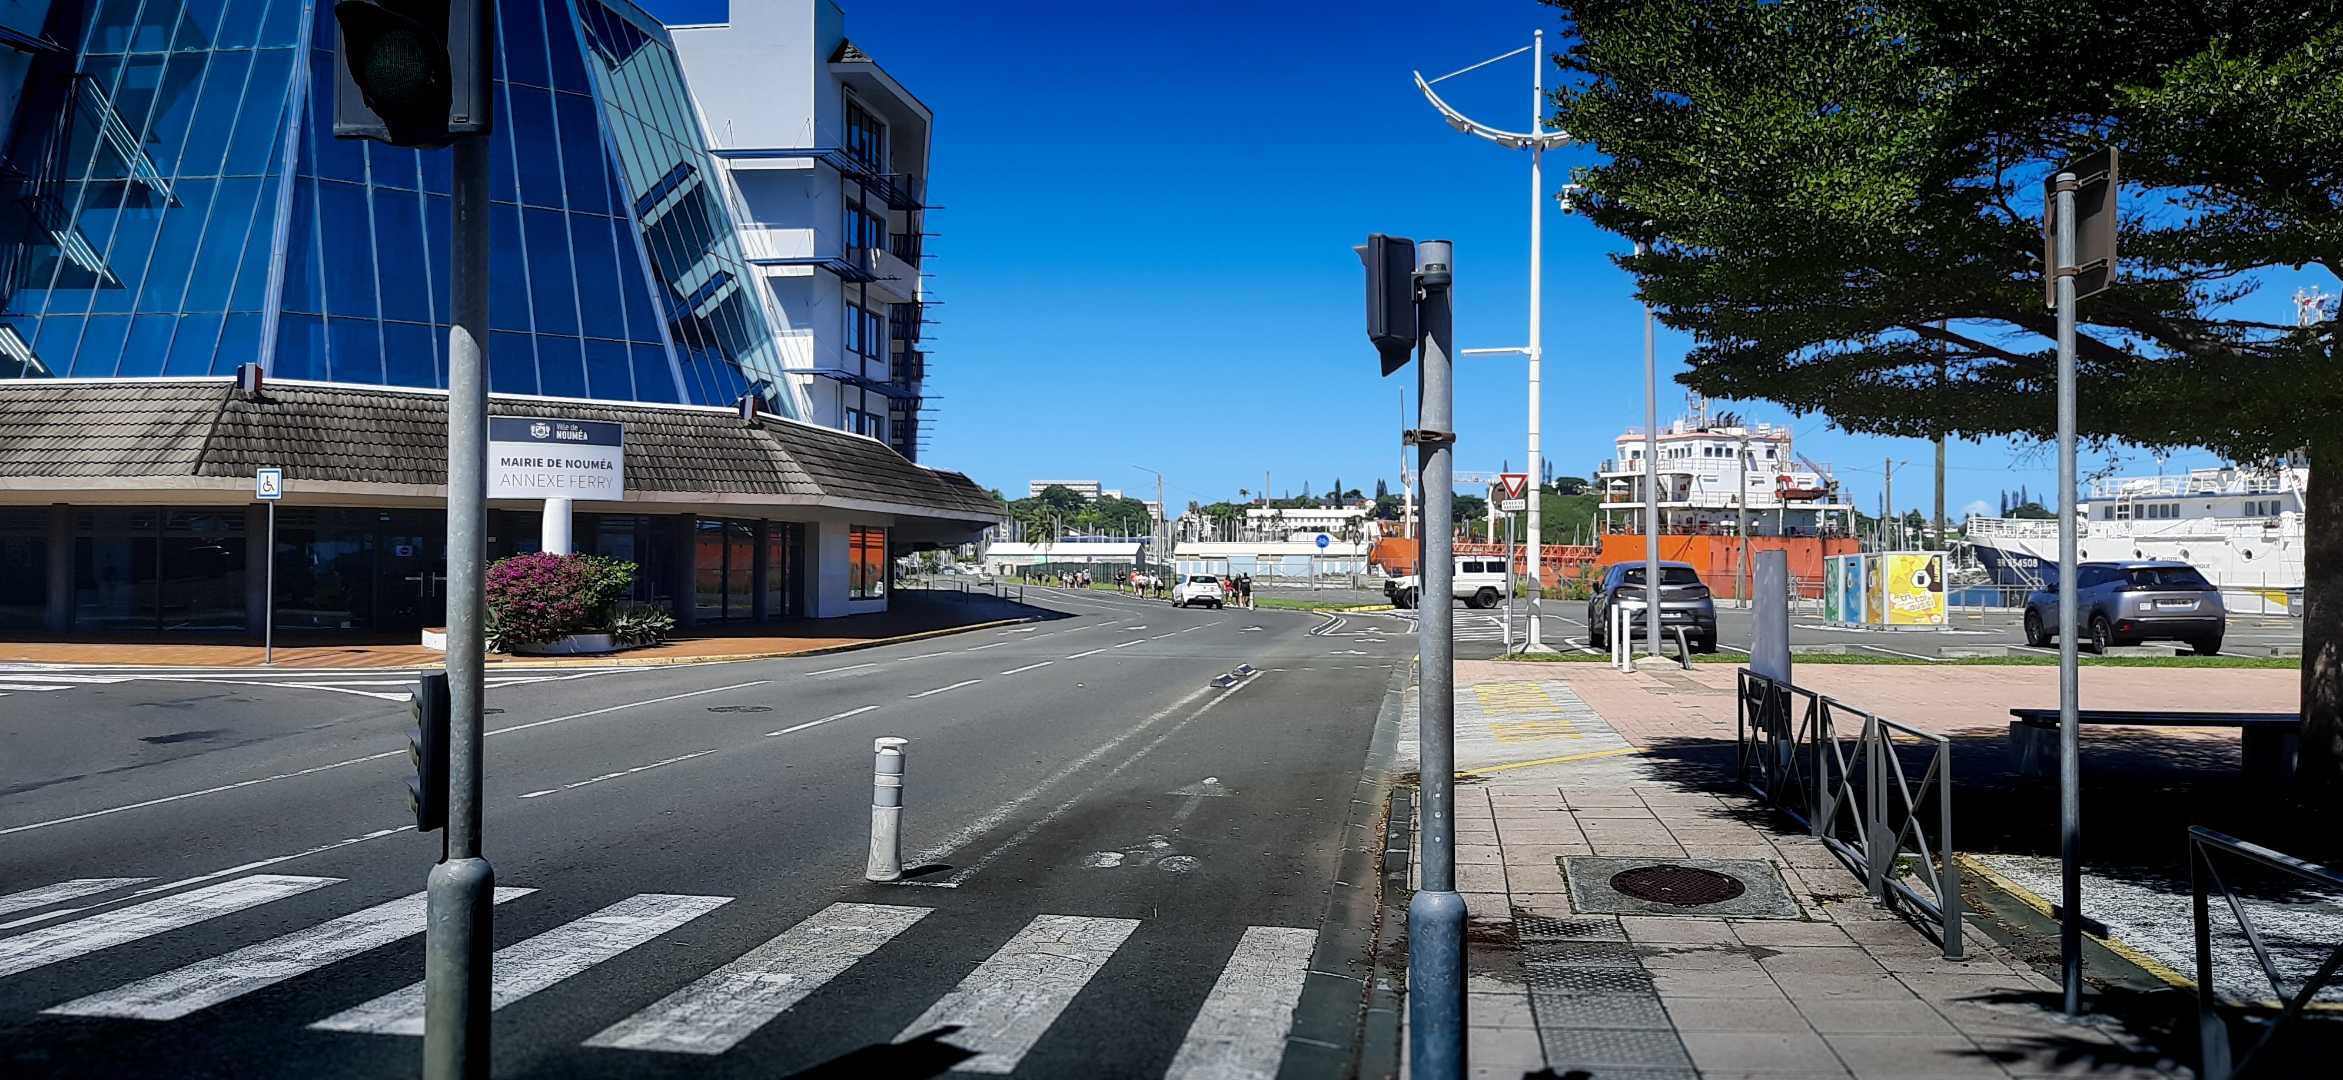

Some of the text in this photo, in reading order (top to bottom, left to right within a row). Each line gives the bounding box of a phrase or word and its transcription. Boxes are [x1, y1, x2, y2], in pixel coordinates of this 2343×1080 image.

[556, 430, 588, 440] NOUMÉA
[501, 457, 613, 470] MAIRIE DE NOUMÉA
[500, 473, 613, 489] ANNEXE FERRY
